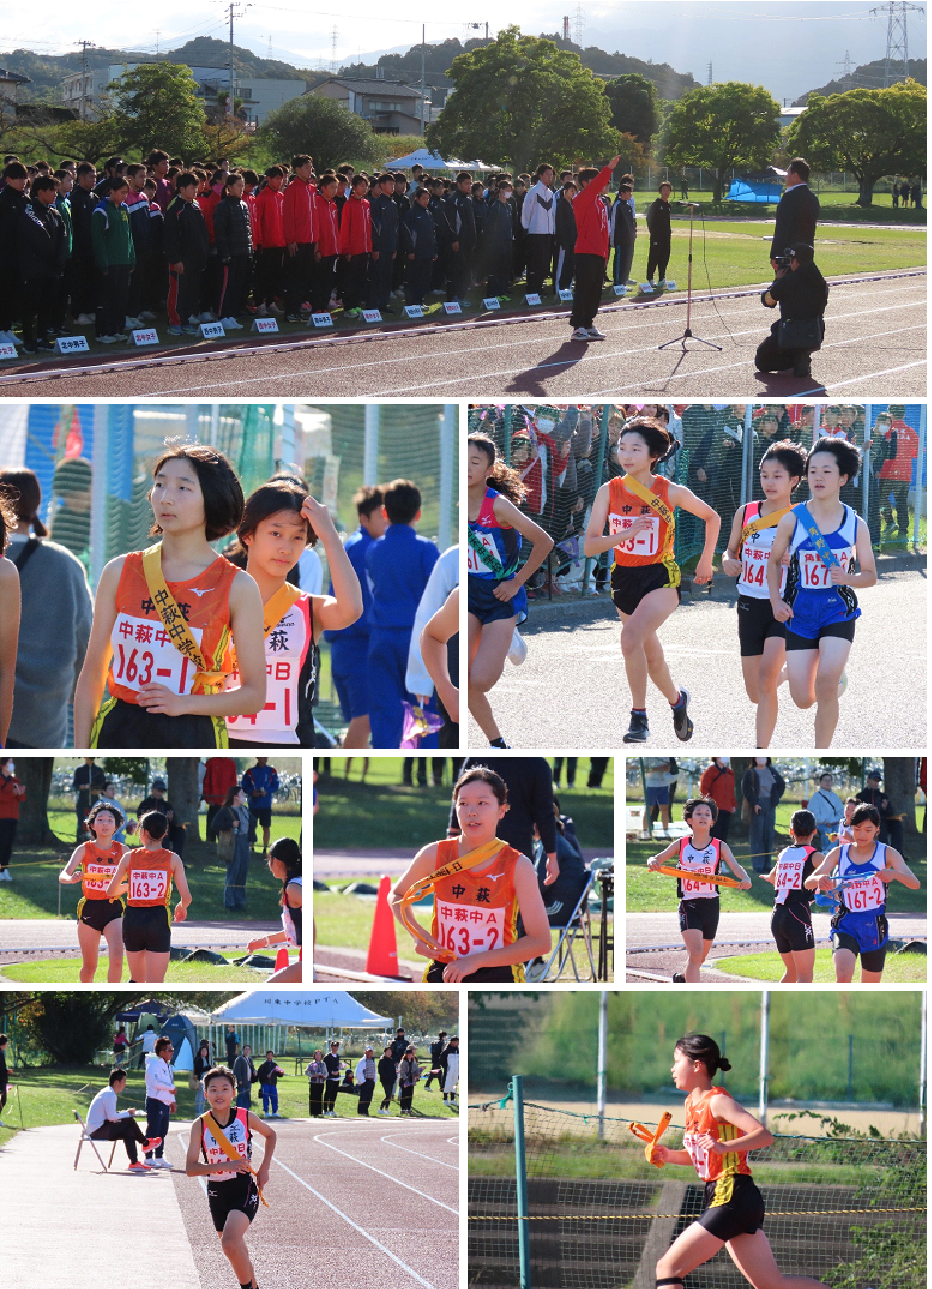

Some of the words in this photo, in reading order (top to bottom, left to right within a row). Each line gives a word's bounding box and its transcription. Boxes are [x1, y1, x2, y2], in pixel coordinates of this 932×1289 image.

[116, 643, 189, 694] 163-1
[132, 882, 165, 898] 163-2
[452, 884, 490, 903] 中萩
[848, 887, 882, 909] 167-2
[441, 906, 496, 924] 中萩中A
[441, 923, 499, 955] 163-2
